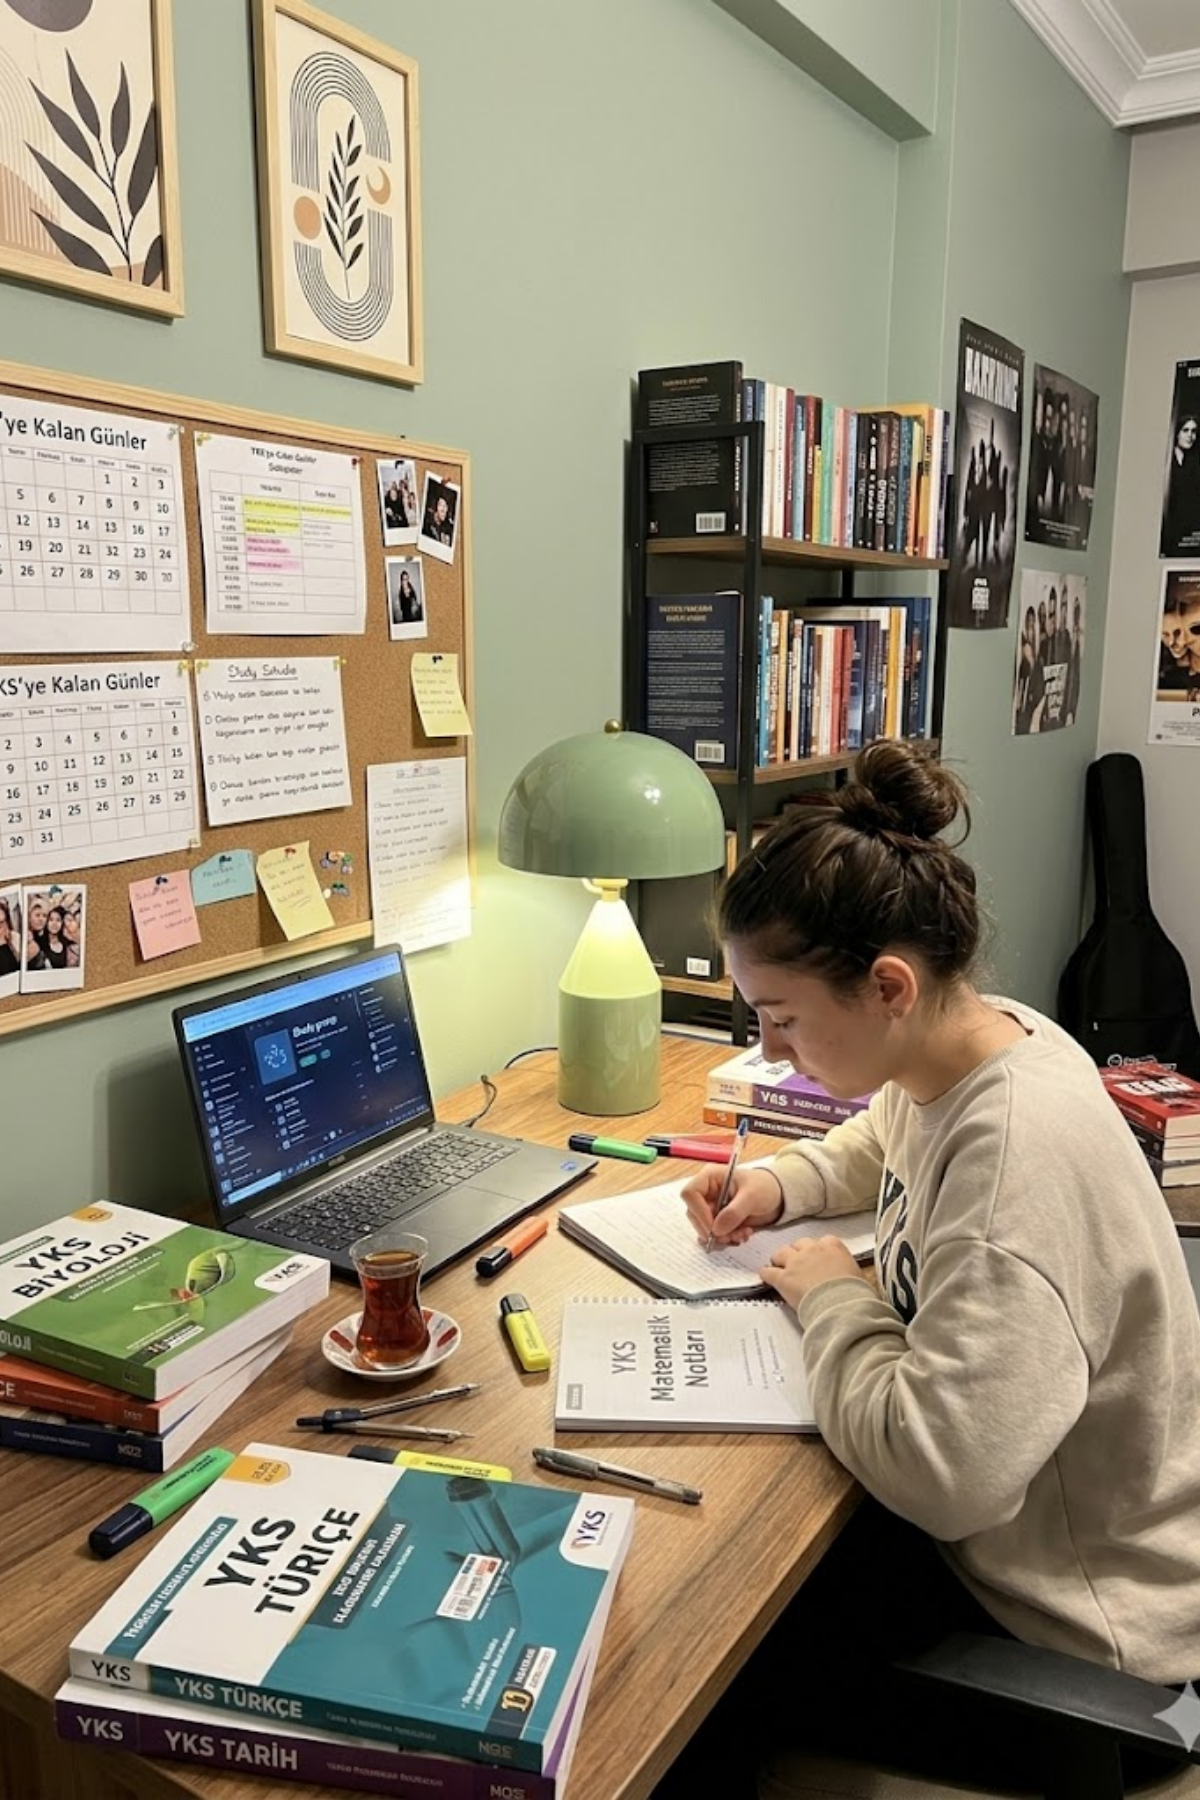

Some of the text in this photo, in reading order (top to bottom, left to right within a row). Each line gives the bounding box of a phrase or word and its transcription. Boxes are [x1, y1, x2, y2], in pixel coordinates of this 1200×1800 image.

[34, 417, 86, 442] Kalan
[90, 426, 147, 451] Günler
[104, 474, 110, 484] 1
[131, 476, 138, 487] 2
[16, 488, 25, 500] 5
[48, 492, 56, 503] 6
[77, 495, 84, 505] 7
[133, 500, 139, 511] 9
[157, 503, 169, 514] 10
[16, 515, 30, 526] 12
[48, 517, 60, 528] 13
[77, 520, 89, 530] 14
[132, 525, 144, 535] 16
[158, 527, 169, 536] 17
[18, 540, 32, 551] 19
[48, 542, 63, 553] 20
[78, 544, 91, 555] 21
[133, 548, 145, 558] 23
[159, 549, 171, 559] 24
[20, 565, 35, 576] 26
[51, 567, 64, 577] 27
[80, 568, 93, 579] 28
[108, 569, 120, 580] 29
[135, 571, 147, 581] 30
[52, 675, 101, 694] Kalan
[106, 672, 160, 691] Günler
[171, 710, 176, 718] 1
[5, 726, 179, 750] 2 3 4 5 6 7 8
[7, 748, 183, 774] 9 10 11 12 13 14 15
[6, 788, 20, 799] 16
[37, 784, 49, 795] 17
[121, 775, 134, 786] 20
[148, 773, 158, 783] 21
[173, 770, 184, 779] 22
[8, 812, 22, 823] 23
[38, 809, 51, 819] 24
[68, 805, 81, 816] 25
[97, 801, 109, 811] 26
[123, 797, 135, 807] 27
[174, 791, 186, 801] 29
[10, 832, 54, 847] 30 31
[14, 1237, 92, 1270] YKS
[611, 1340, 637, 1375] YKS
[684, 1330, 709, 1388] Notları
[571, 1510, 606, 1548] YKS
[204, 1516, 296, 1588] YKS
[91, 1659, 131, 1683] YKS
[174, 1677, 304, 1719] YKS TÜRKÇE
[76, 1715, 124, 1741] YKS
[164, 1729, 215, 1758] YKS
[220, 1738, 299, 1771] TARİH
